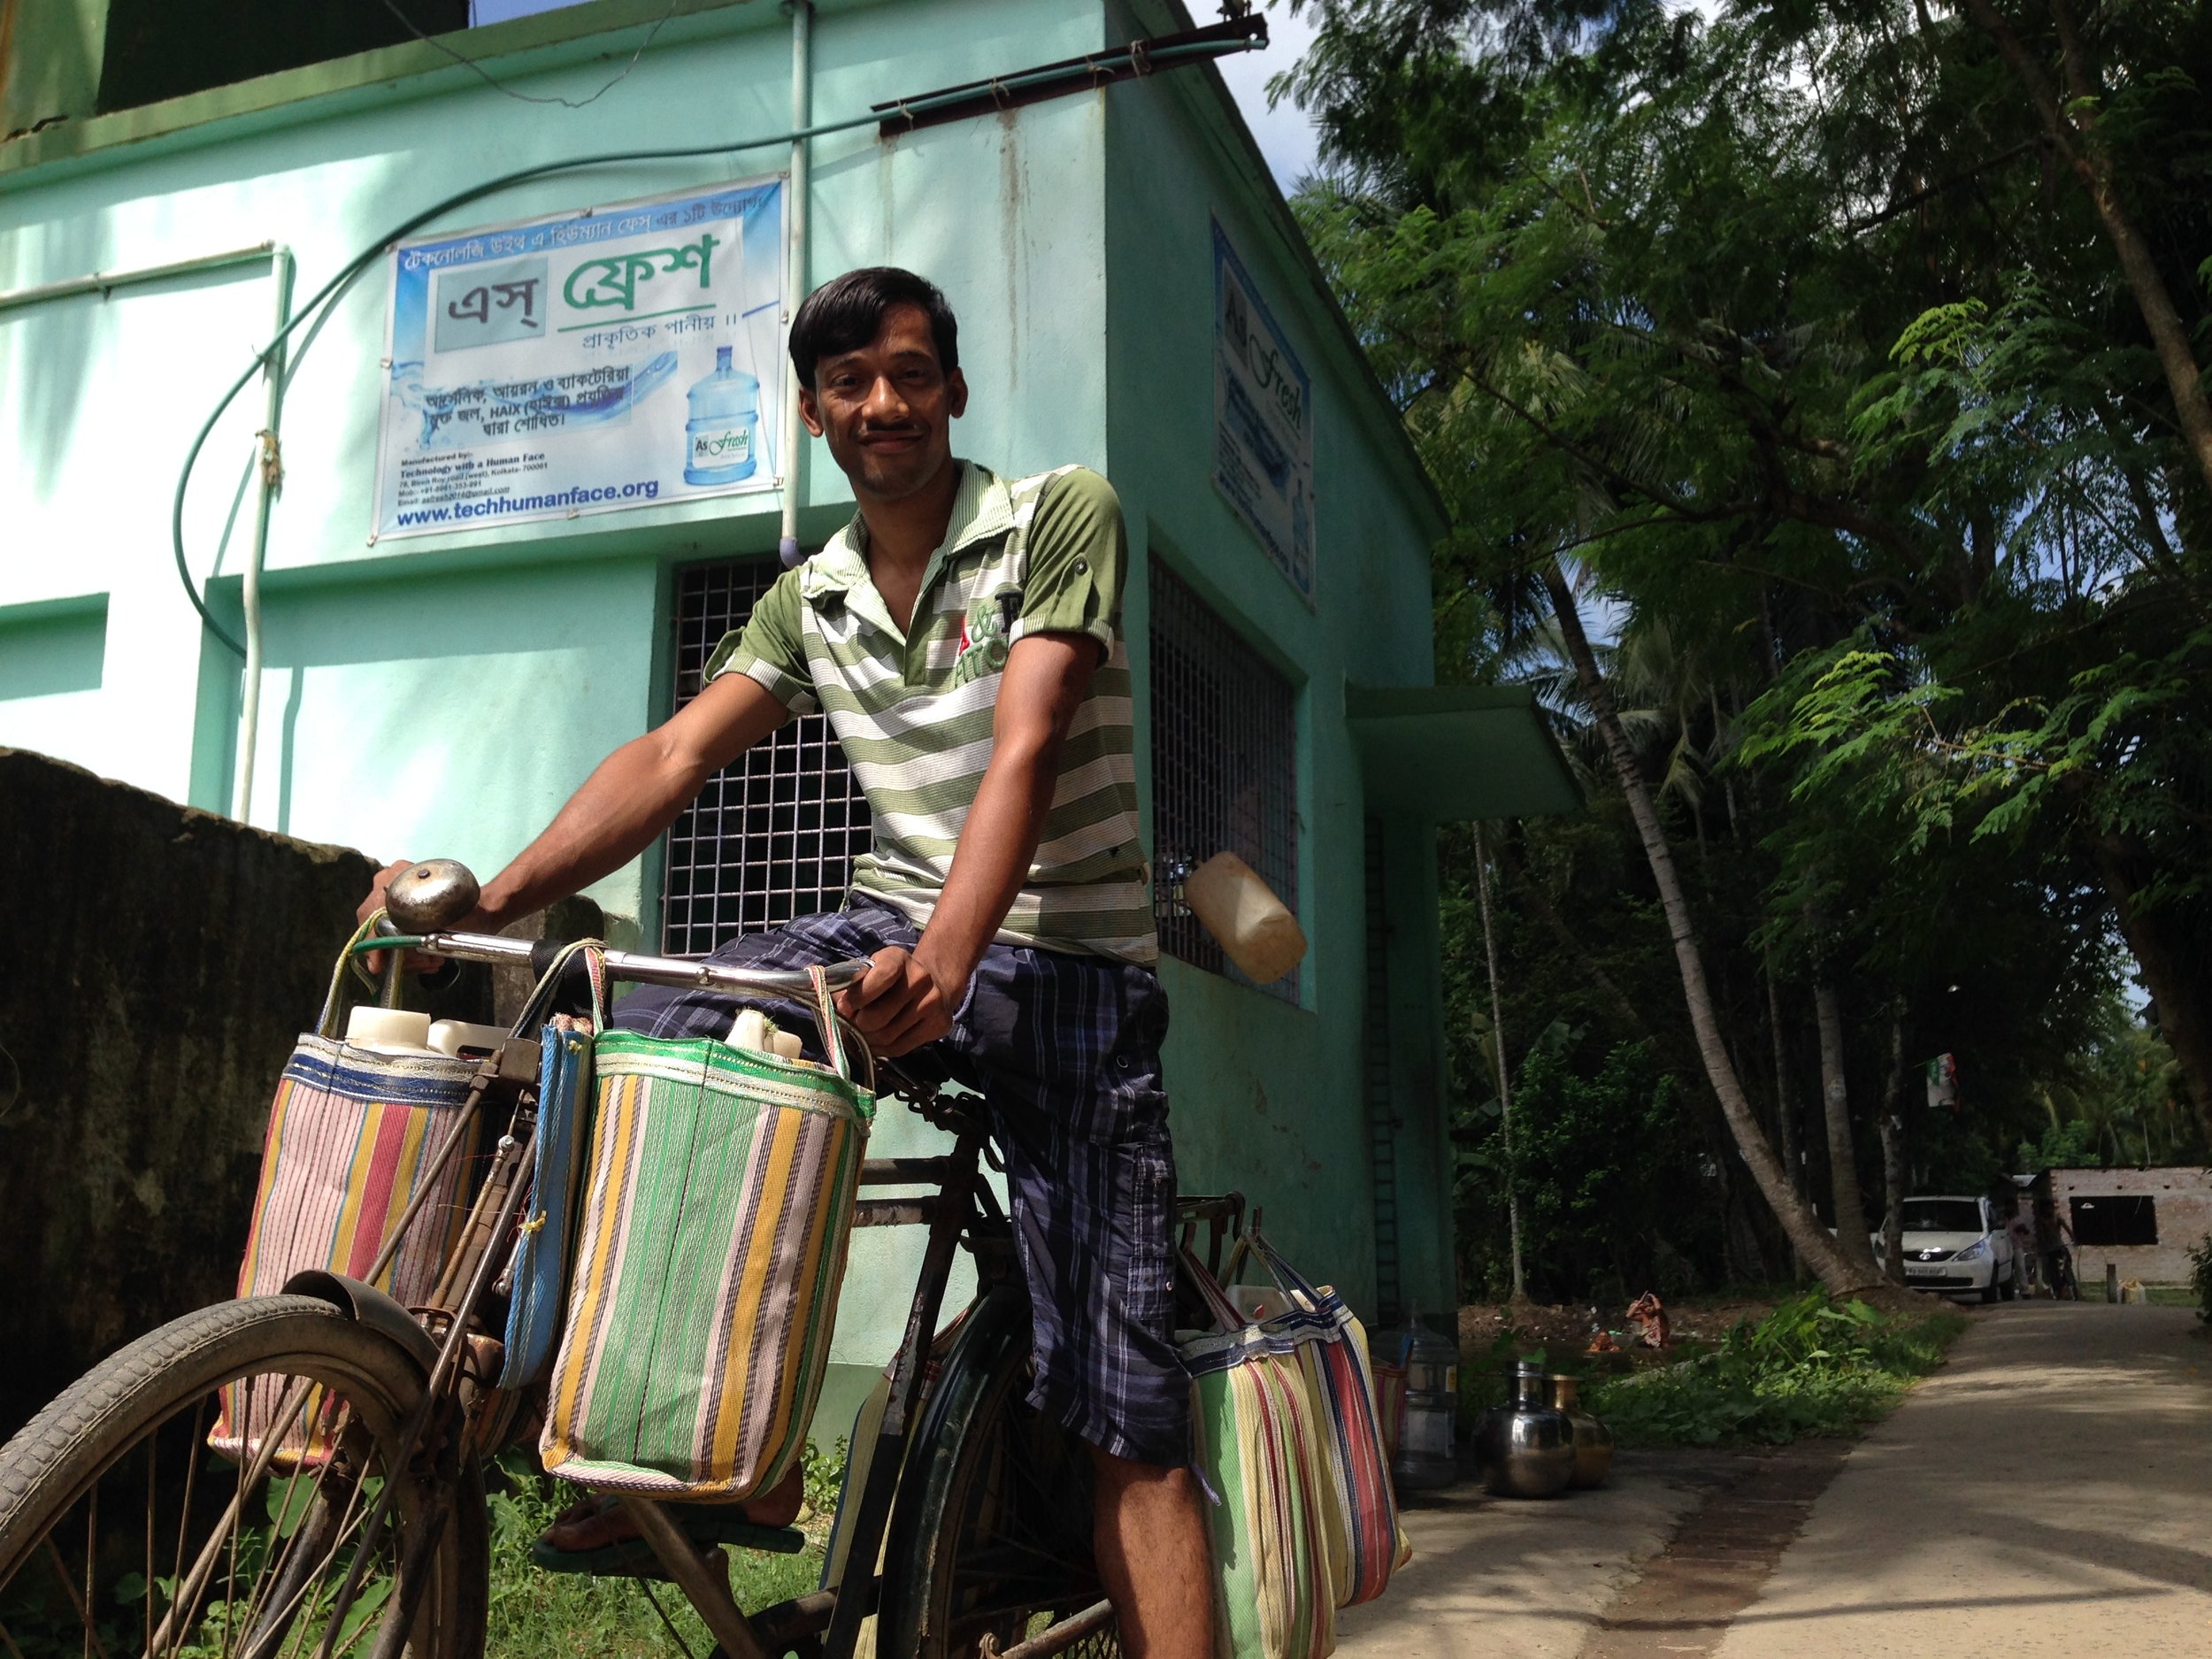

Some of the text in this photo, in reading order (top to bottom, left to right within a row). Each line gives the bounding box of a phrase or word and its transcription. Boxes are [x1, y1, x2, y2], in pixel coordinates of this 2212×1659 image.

[563, 233, 720, 311] ফ্রেশ
[448, 278, 540, 328] এস্
[582, 324, 657, 349] প্রাকৃতিক
[664, 312, 716, 334] পানীয়
[489, 403, 522, 419] HAIX
[400, 464, 452, 479] Technology
[455, 460, 475, 472] with
[487, 457, 520, 468] Human
[523, 452, 546, 463] Face
[396, 478, 660, 526] www.techhumanface.org
